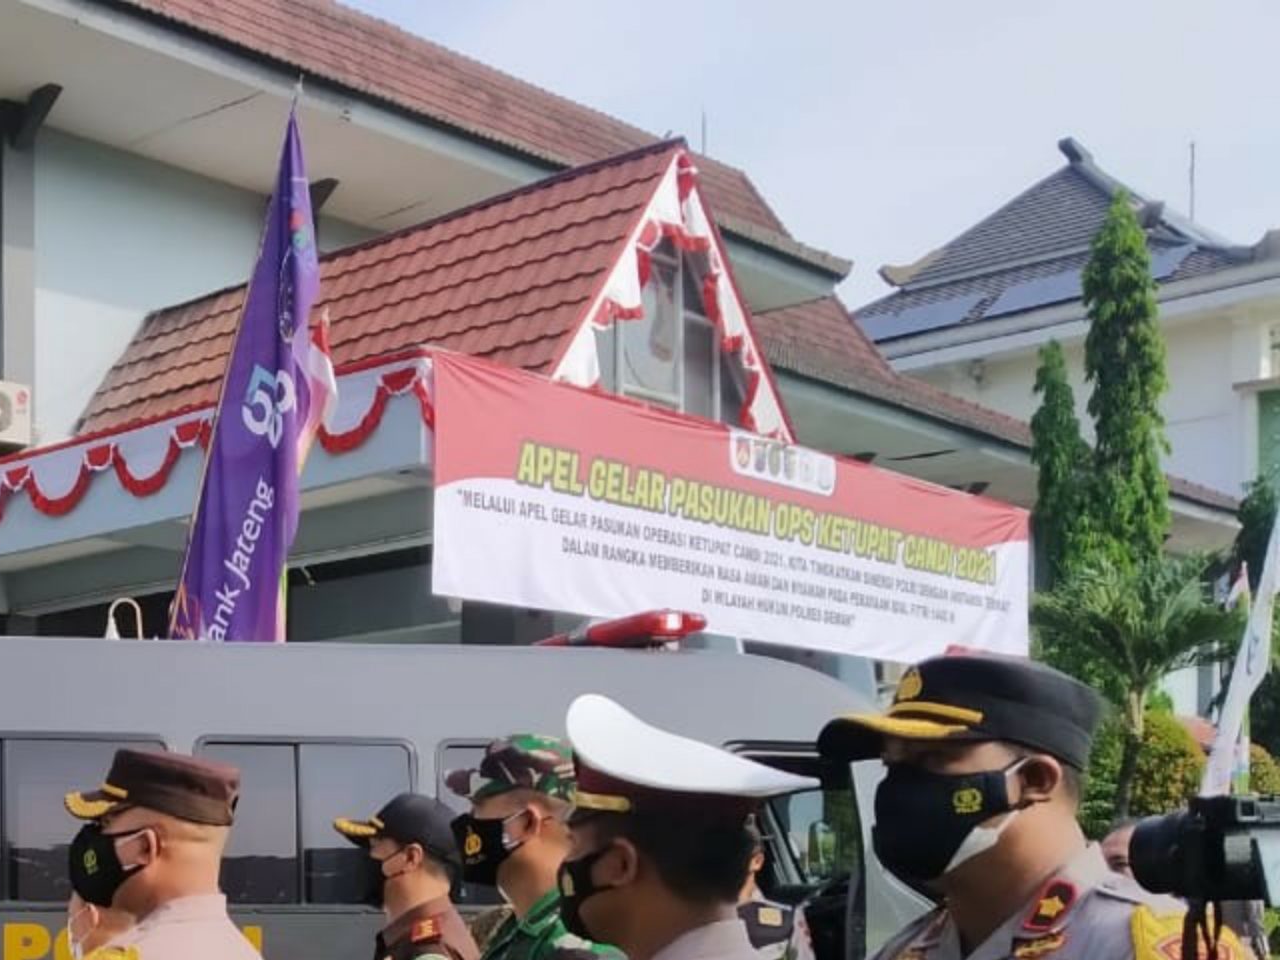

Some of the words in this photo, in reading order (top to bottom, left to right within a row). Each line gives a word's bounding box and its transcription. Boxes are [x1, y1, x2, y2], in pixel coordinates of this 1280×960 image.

[518, 440, 585, 497] APEL
[588, 458, 667, 513] GELAR
[668, 478, 770, 536] PASUKAN
[774, 502, 815, 546] OPS
[816, 513, 902, 565] KETUPAT
[903, 534, 954, 578] CANDI
[955, 547, 996, 586] 2021
[519, 501, 548, 522] APEL
[552, 507, 587, 529] GELAR
[591, 514, 640, 539] PASUKAN
[644, 525, 687, 546] OPERASI
[689, 533, 732, 554] KETUPAT
[734, 543, 761, 561] CANDI
[206, 583, 240, 640] ank
[224, 477, 274, 590] Jateng
[562, 536, 599, 557] DALAM
[602, 543, 646, 566] RANGKA
[649, 554, 715, 578] MEMBERIKAN
[717, 565, 741, 583] RASA
[771, 576, 788, 593] DAN
[701, 587, 712, 603] DI
[714, 590, 755, 610] WILAYAH
